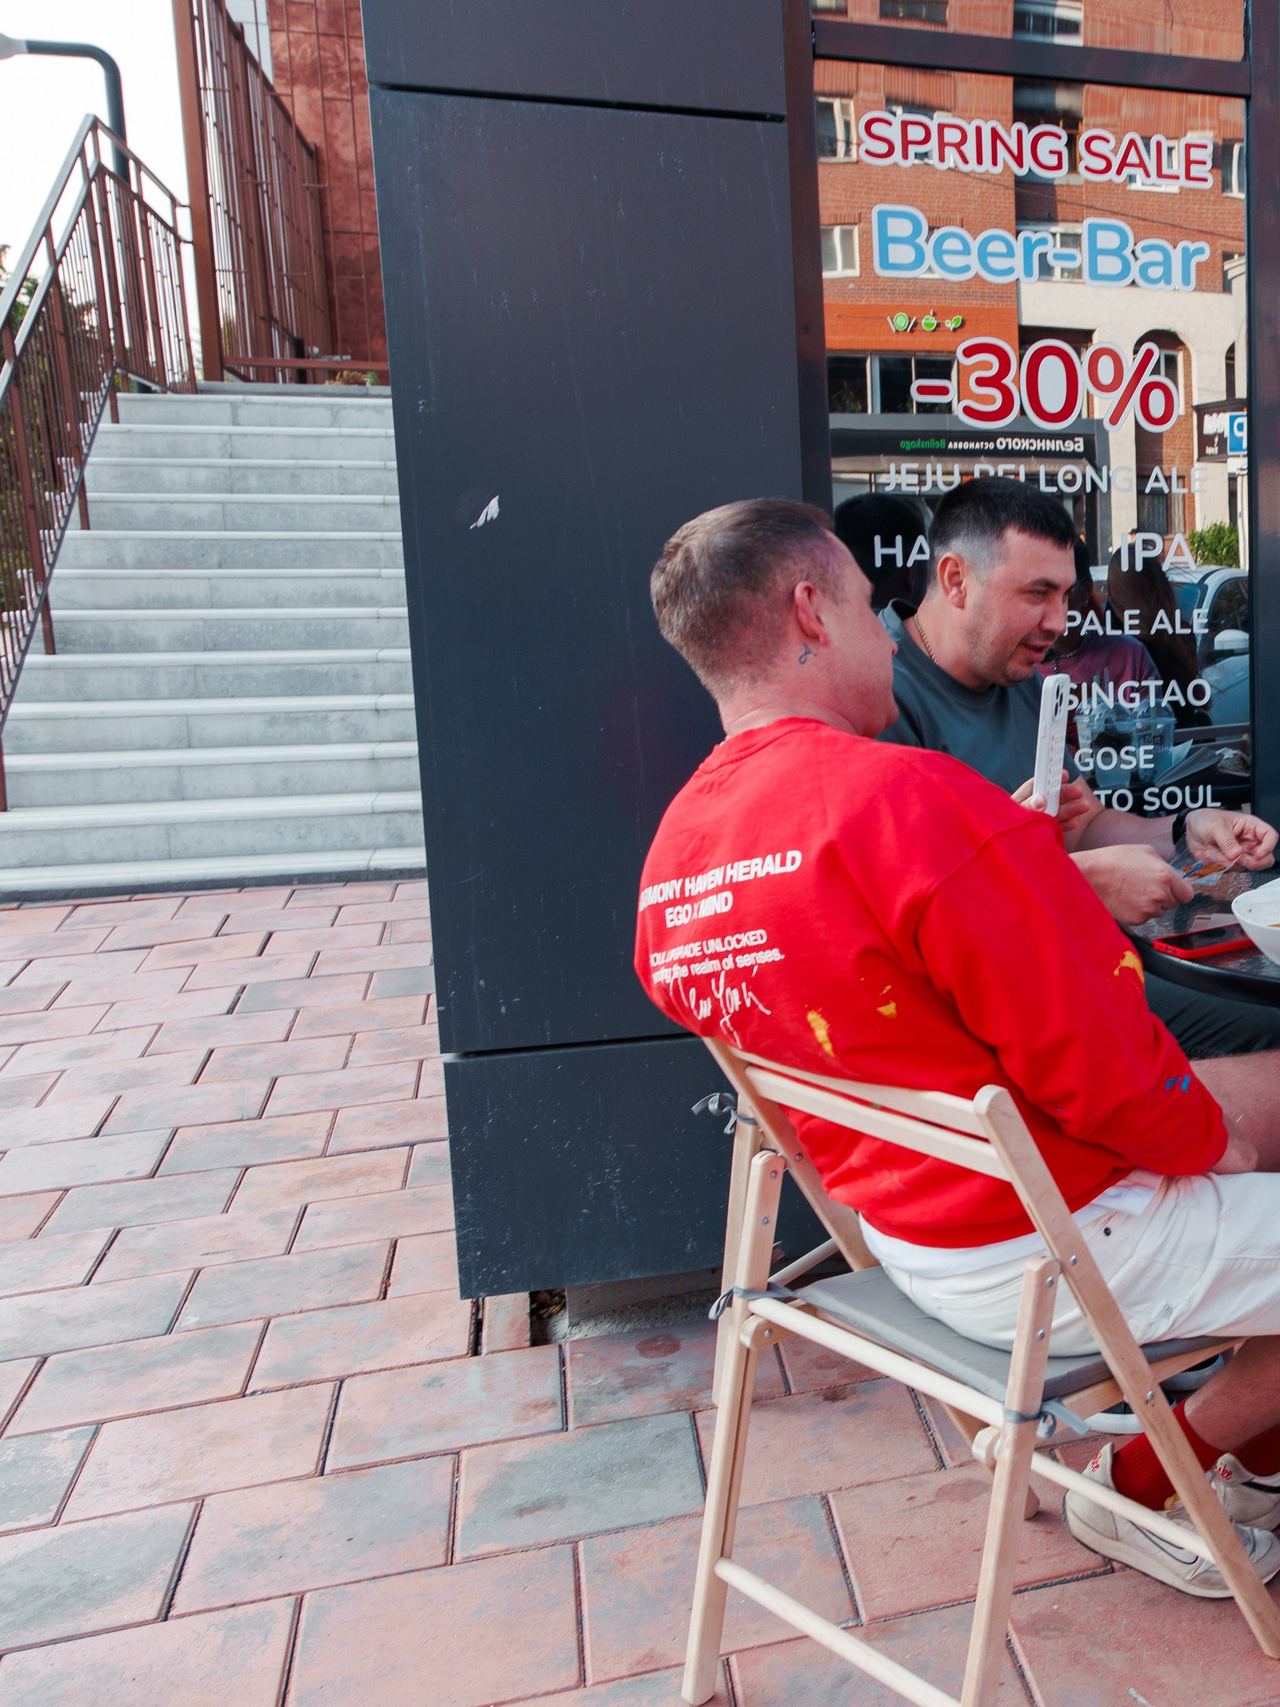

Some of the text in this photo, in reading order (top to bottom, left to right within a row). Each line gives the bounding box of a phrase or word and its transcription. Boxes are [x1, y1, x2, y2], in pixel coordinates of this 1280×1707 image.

[863, 116, 1212, 184] SPRING SALE
[877, 209, 1206, 288] Beer-Bar
[916, 344, 1174, 428] -30%
[884, 463, 960, 493] JEJU
[1145, 466, 1207, 494] ALE
[1120, 532, 1197, 573] IPA
[1064, 609, 1209, 637] PALE ALE
[1074, 746, 1155, 772] GOSE
[1143, 784, 1221, 812] SOUL
[684, 866, 726, 898] HAVEN
[725, 850, 802, 884] HERALD
[665, 901, 692, 928] EGO
[698, 891, 733, 919] MIND
[703, 929, 767, 955] UNLOCKED
[690, 957, 721, 976] realm
[722, 953, 734, 971] of
